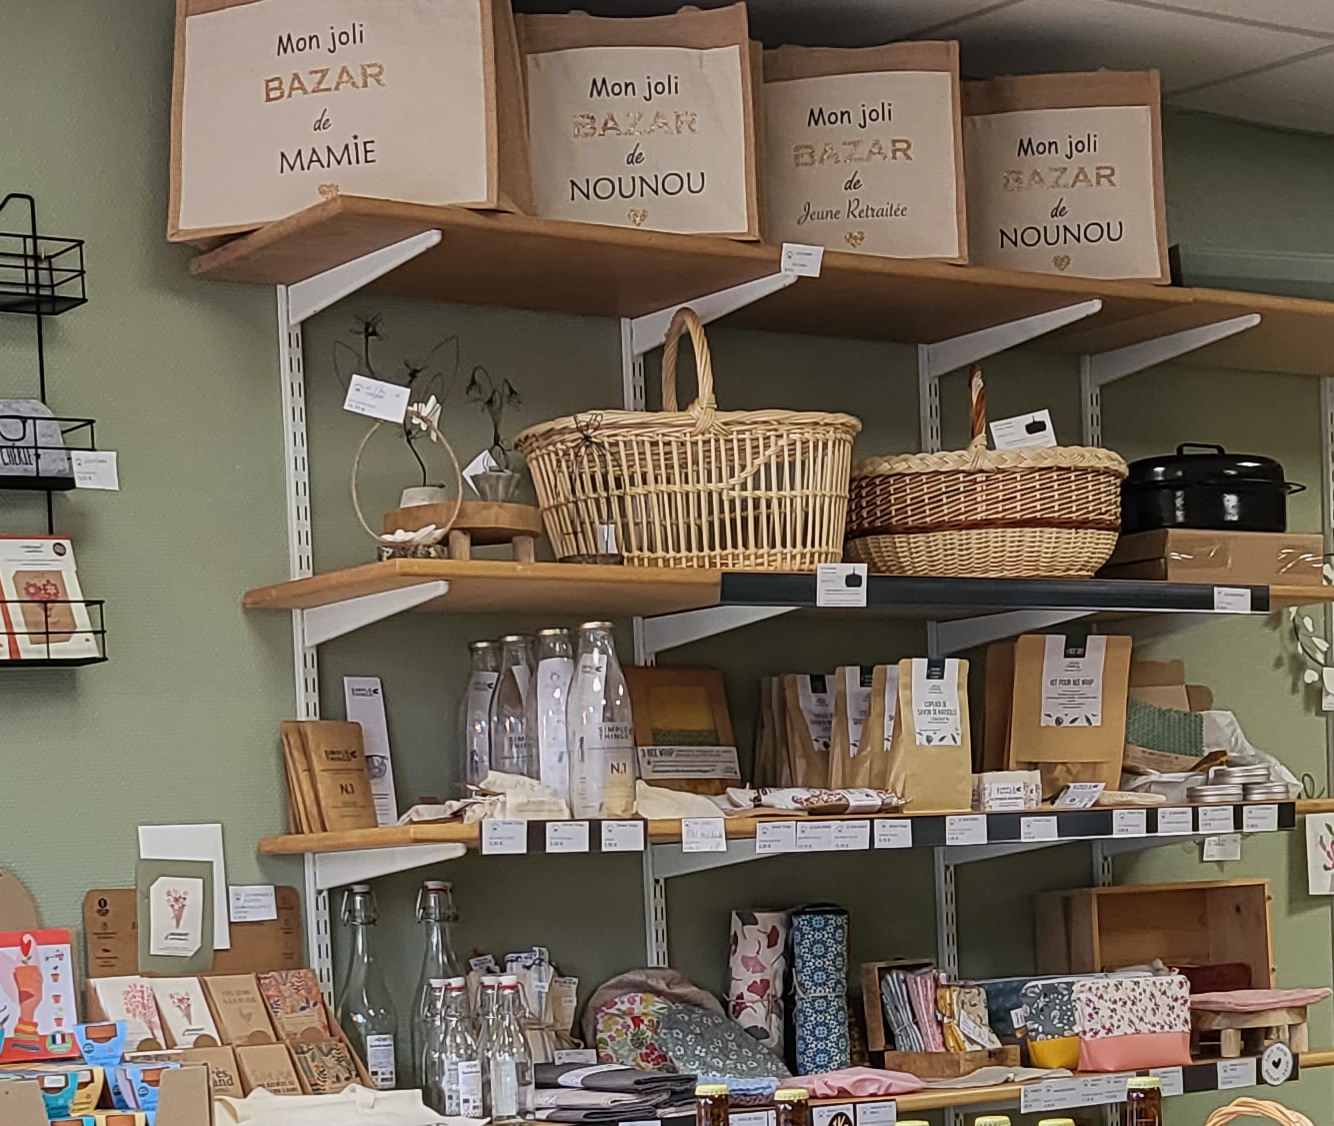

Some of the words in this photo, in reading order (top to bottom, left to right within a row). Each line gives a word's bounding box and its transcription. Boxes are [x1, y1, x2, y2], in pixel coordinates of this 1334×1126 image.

[277, 33, 320, 56] Mon
[328, 23, 364, 54] joli
[264, 62, 386, 103] BAZAR
[590, 77, 636, 98] Mon
[644, 75, 679, 101] joli
[314, 108, 332, 132] de
[573, 111, 699, 138] BAZAR
[808, 106, 851, 127] Mon
[858, 102, 892, 128] joli
[626, 143, 645, 165] de
[793, 138, 913, 161] BAZAR
[1017, 137, 1058, 157] Mon
[1065, 133, 1097, 159] joli
[569, 172, 705, 201] NOUNOU
[844, 171, 862, 191] de
[1003, 166, 1116, 191] BAZAR
[798, 202, 840, 225] Jeune
[1051, 198, 1068, 218] de
[999, 221, 1123, 248] NOUNOU
